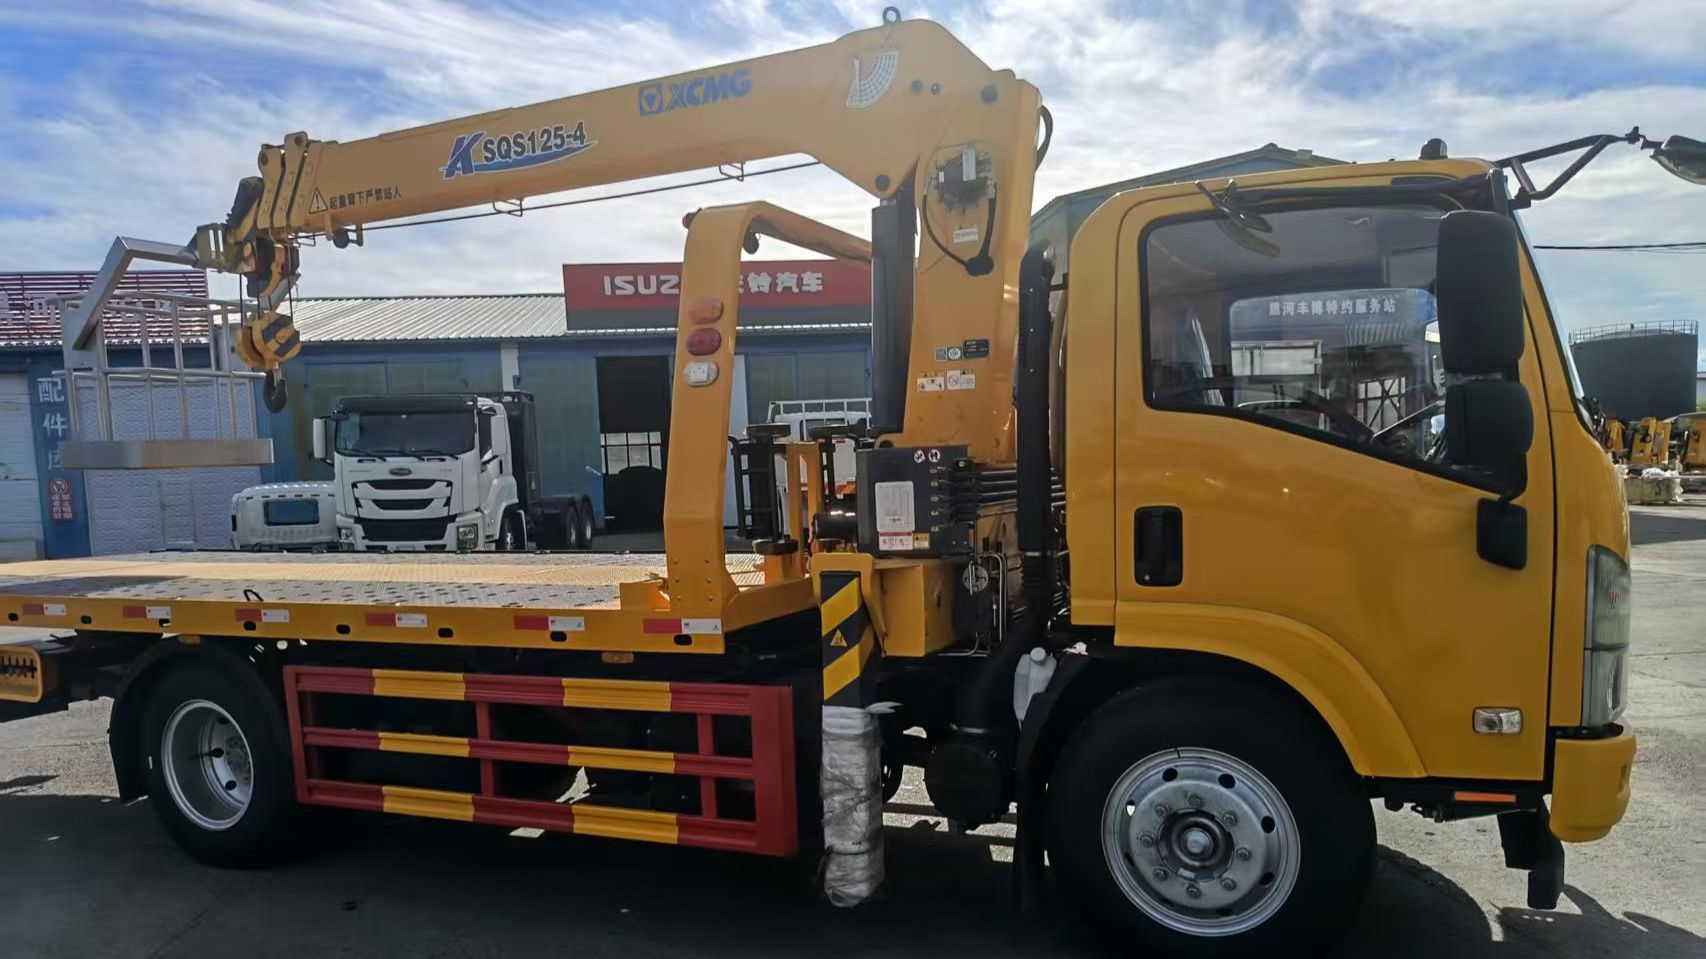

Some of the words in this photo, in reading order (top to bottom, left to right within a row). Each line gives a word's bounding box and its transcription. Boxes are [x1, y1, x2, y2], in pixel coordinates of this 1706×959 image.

[667, 70, 752, 111] XCMG
[483, 121, 586, 162] SQS125-4
[604, 275, 680, 296] ISUZ
[737, 272, 823, 293] 铃汽车
